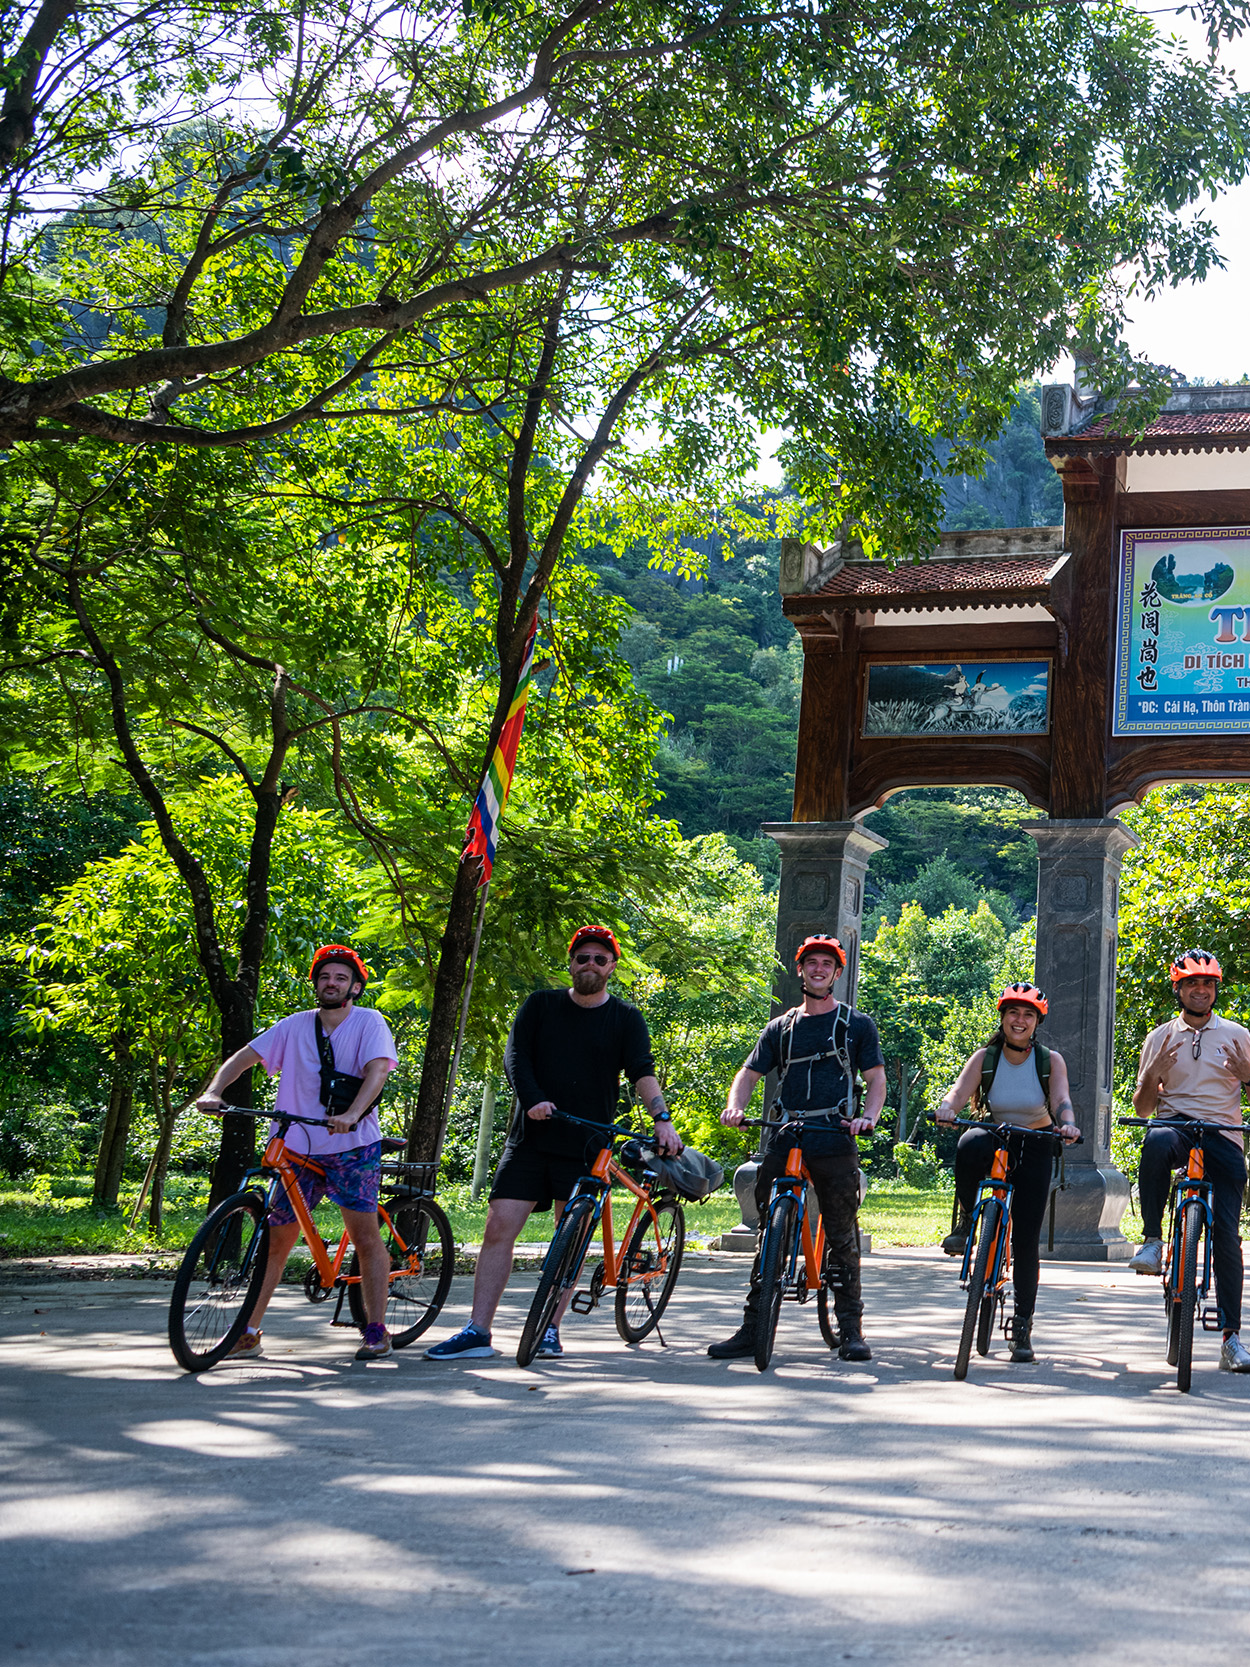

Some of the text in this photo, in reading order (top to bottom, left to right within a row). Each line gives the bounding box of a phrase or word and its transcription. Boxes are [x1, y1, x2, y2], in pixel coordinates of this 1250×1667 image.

[1184, 655, 1201, 669] DI
[1206, 651, 1244, 669] TÍCH
[1164, 700, 1180, 713] Cái
[1183, 700, 1199, 715] Hạ,
[1202, 699, 1225, 712] Thôn
